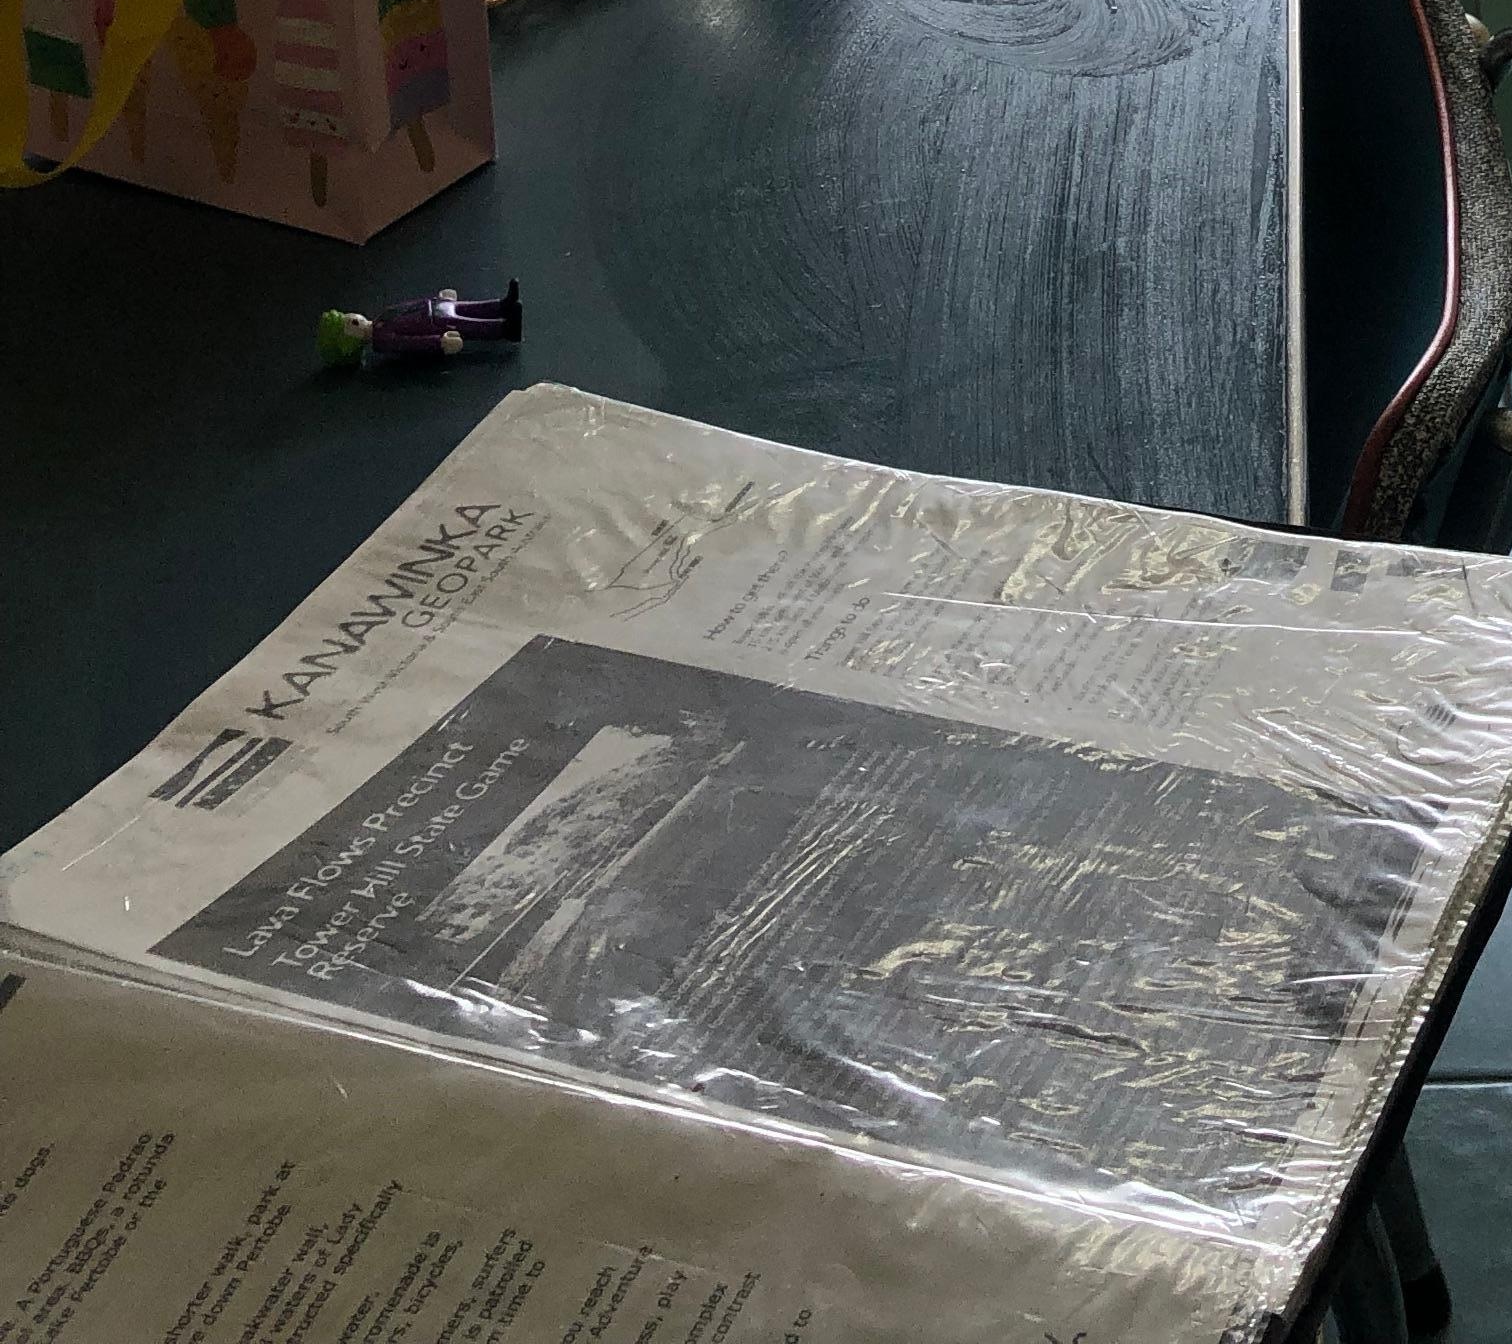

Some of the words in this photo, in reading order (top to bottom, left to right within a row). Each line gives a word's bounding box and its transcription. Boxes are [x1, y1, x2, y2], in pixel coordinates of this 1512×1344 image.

[402, 509, 534, 628] GEOPARK
[730, 602, 746, 614] to
[246, 504, 501, 720] KANAWINKA
[841, 613, 857, 625] to
[223, 906, 300, 957] Lava
[287, 836, 376, 901] Flows
[362, 741, 474, 832] Precinct
[271, 901, 360, 966] Tower
[351, 860, 406, 899] Hill
[395, 804, 465, 858] State
[456, 738, 530, 800] Game
[307, 892, 416, 981] Reserve
[123, 1133, 176, 1201] rotunda
[247, 1184, 281, 1226] park
[276, 1161, 296, 1182] at
[28, 1198, 107, 1294] Portuguese
[46, 1307, 75, 1344] ake
[139, 1179, 167, 1208] the
[203, 1277, 242, 1326] down
[236, 1204, 292, 1272] Pertobe
[333, 1179, 403, 1276] specifically
[472, 1226, 516, 1290] surfers
[239, 1267, 294, 1344] akwater
[271, 1271, 318, 1334] waters
[314, 1247, 332, 1269] of
[326, 1203, 363, 1244] Lady
[363, 1251, 428, 1344] romenade
[421, 1231, 441, 1249] is
[403, 1239, 464, 1316] bicycles,
[478, 1239, 533, 1320] patrolled
[498, 1282, 532, 1327] time
[525, 1261, 546, 1279] to
[562, 1321, 584, 1344] ou
[580, 1265, 616, 1317] reach
[590, 1246, 653, 1338] Adventure
[657, 1269, 689, 1310] play
[711, 1270, 762, 1344] contrast
[685, 1282, 729, 1344] omplex
[793, 1308, 813, 1329] to
